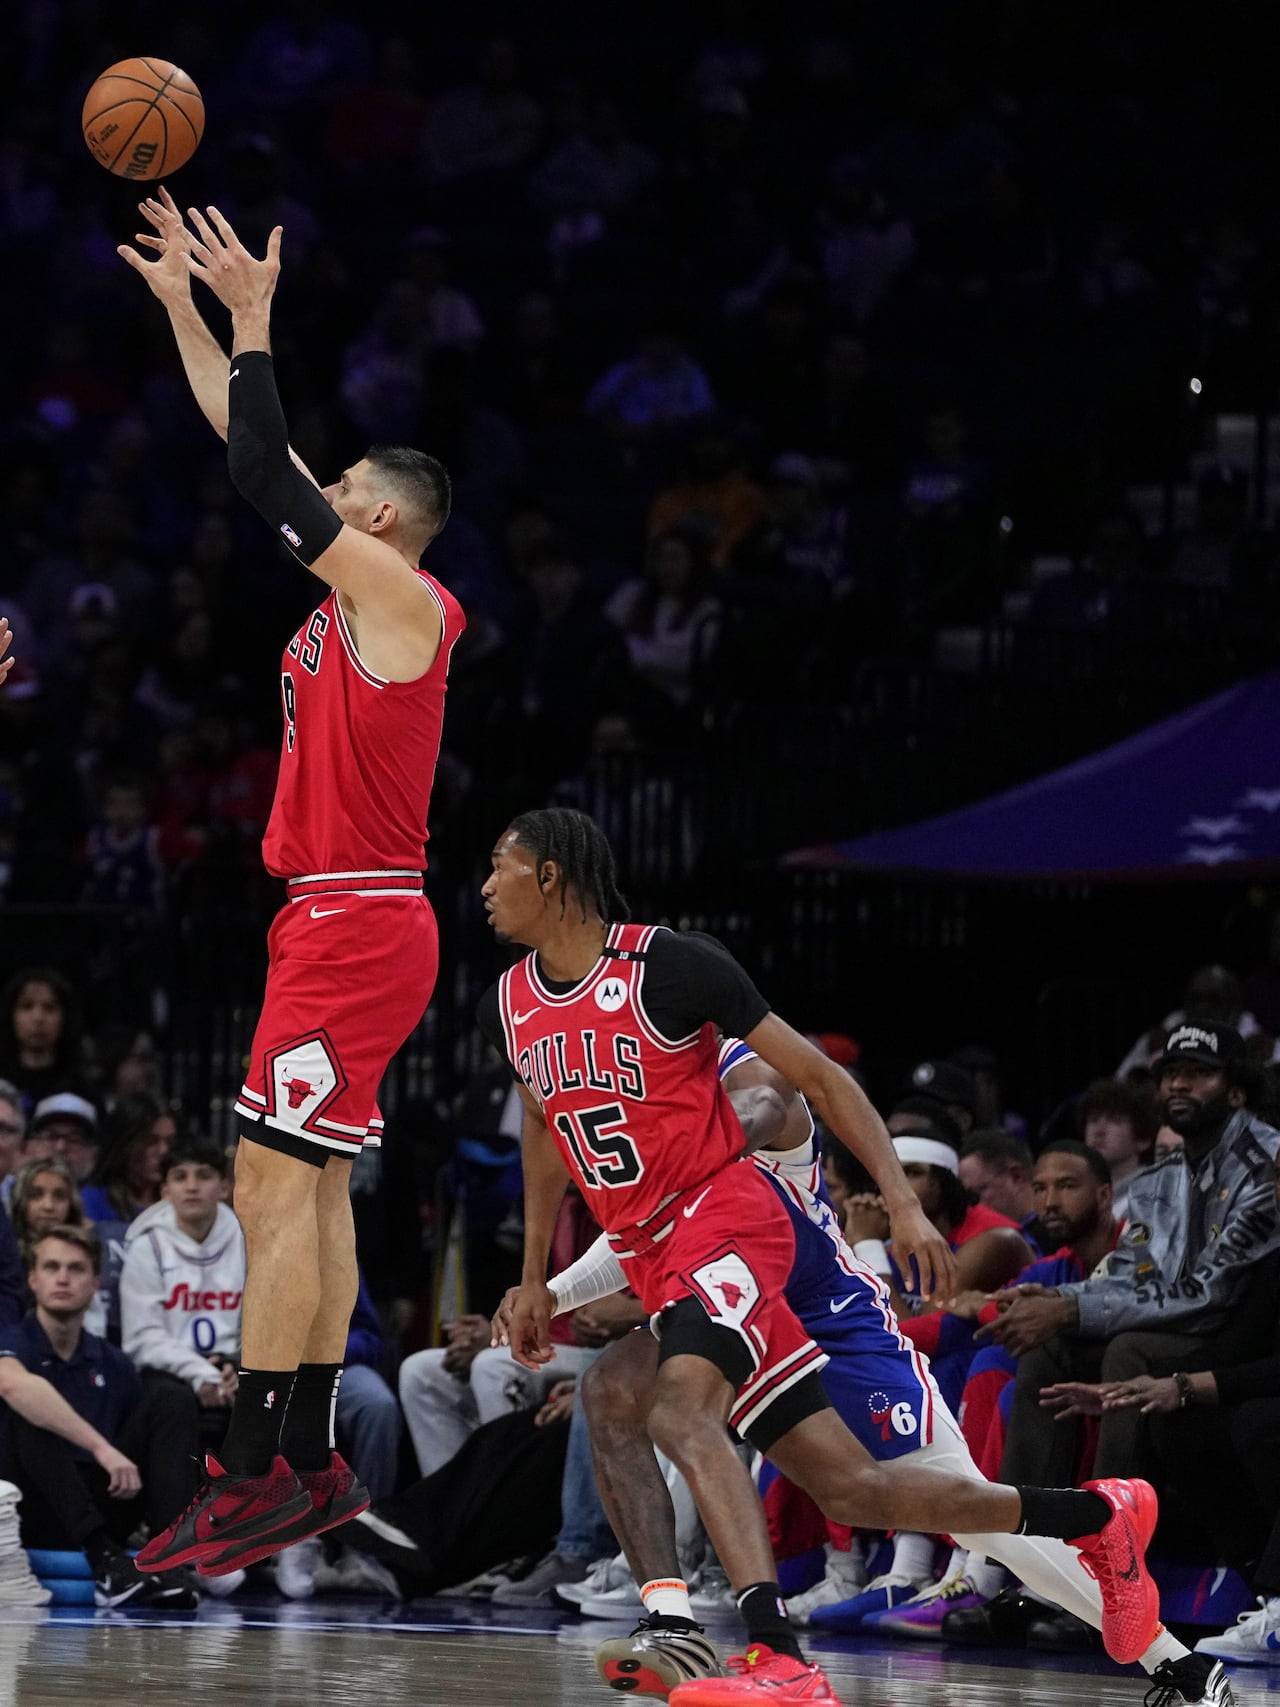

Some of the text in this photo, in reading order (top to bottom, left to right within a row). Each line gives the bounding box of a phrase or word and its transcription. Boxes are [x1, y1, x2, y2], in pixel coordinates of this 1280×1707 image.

[281, 672, 296, 753] 9
[618, 951, 630, 960] 10
[519, 1029, 647, 1112] BULLS
[554, 1101, 644, 1189] 15
[192, 1317, 216, 1352] 0
[870, 1402, 917, 1442] 76
